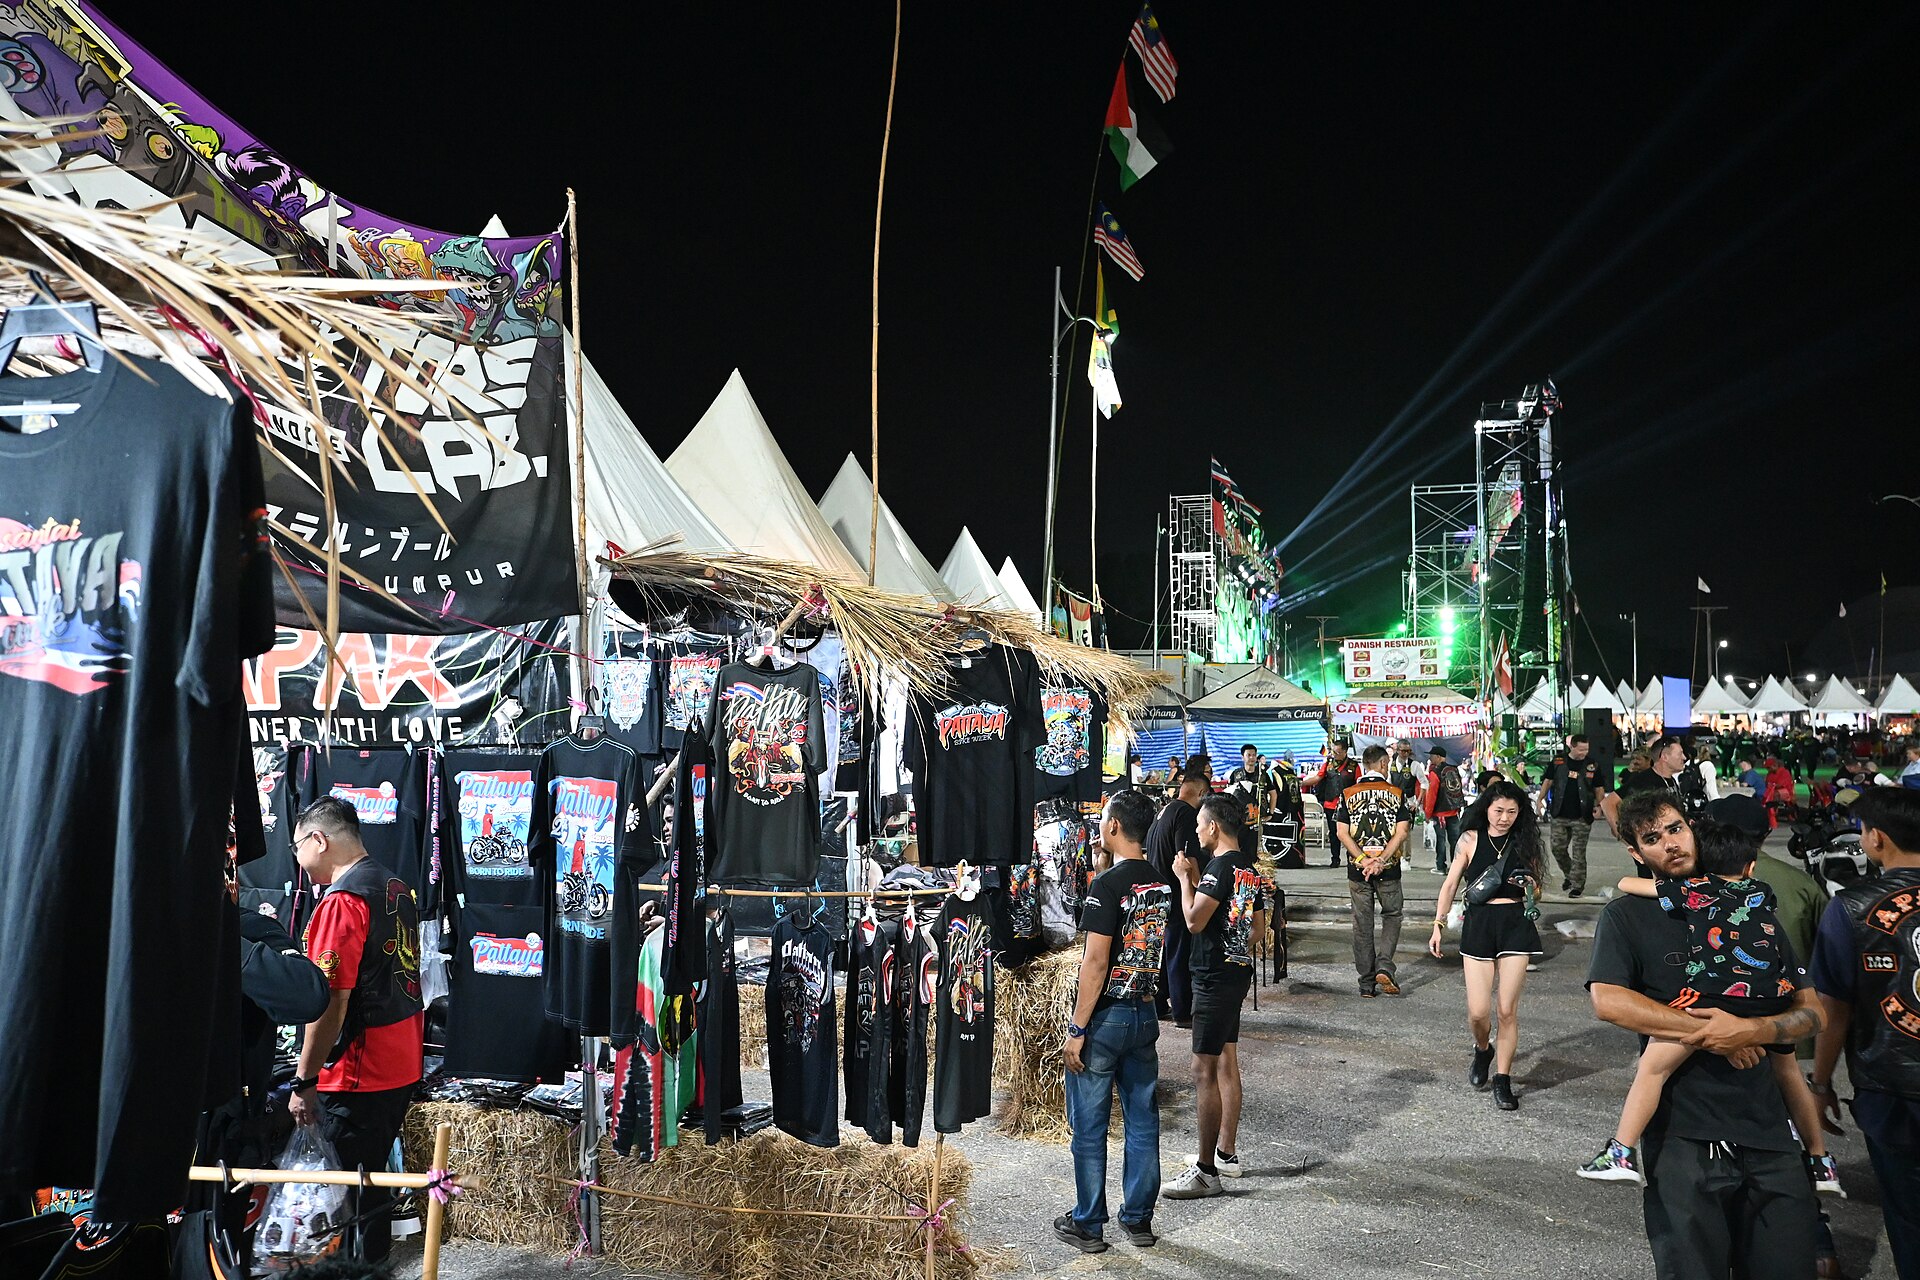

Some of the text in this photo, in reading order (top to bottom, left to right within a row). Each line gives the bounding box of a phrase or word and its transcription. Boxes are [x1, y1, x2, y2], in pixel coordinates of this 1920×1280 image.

[356, 561, 515, 595] UMPUR
[1348, 640, 1382, 649] DANISH
[1235, 691, 1281, 700] Chang
[1381, 691, 1429, 699] Chang
[1149, 708, 1177, 717] Chang
[1293, 709, 1323, 719] Chang
[1336, 703, 1478, 715] CAFE KRONBORG
[1363, 715, 1448, 724] RESTAURANT
[314, 717, 377, 742] WITH
[391, 717, 464, 742] LOVE
[938, 713, 1007, 750] PATTAYA
[454, 772, 535, 805] Pattaya
[469, 867, 525, 876] BORN TO RIDE
[470, 938, 544, 973] Pattaya
[1866, 955, 1894, 969] MC
